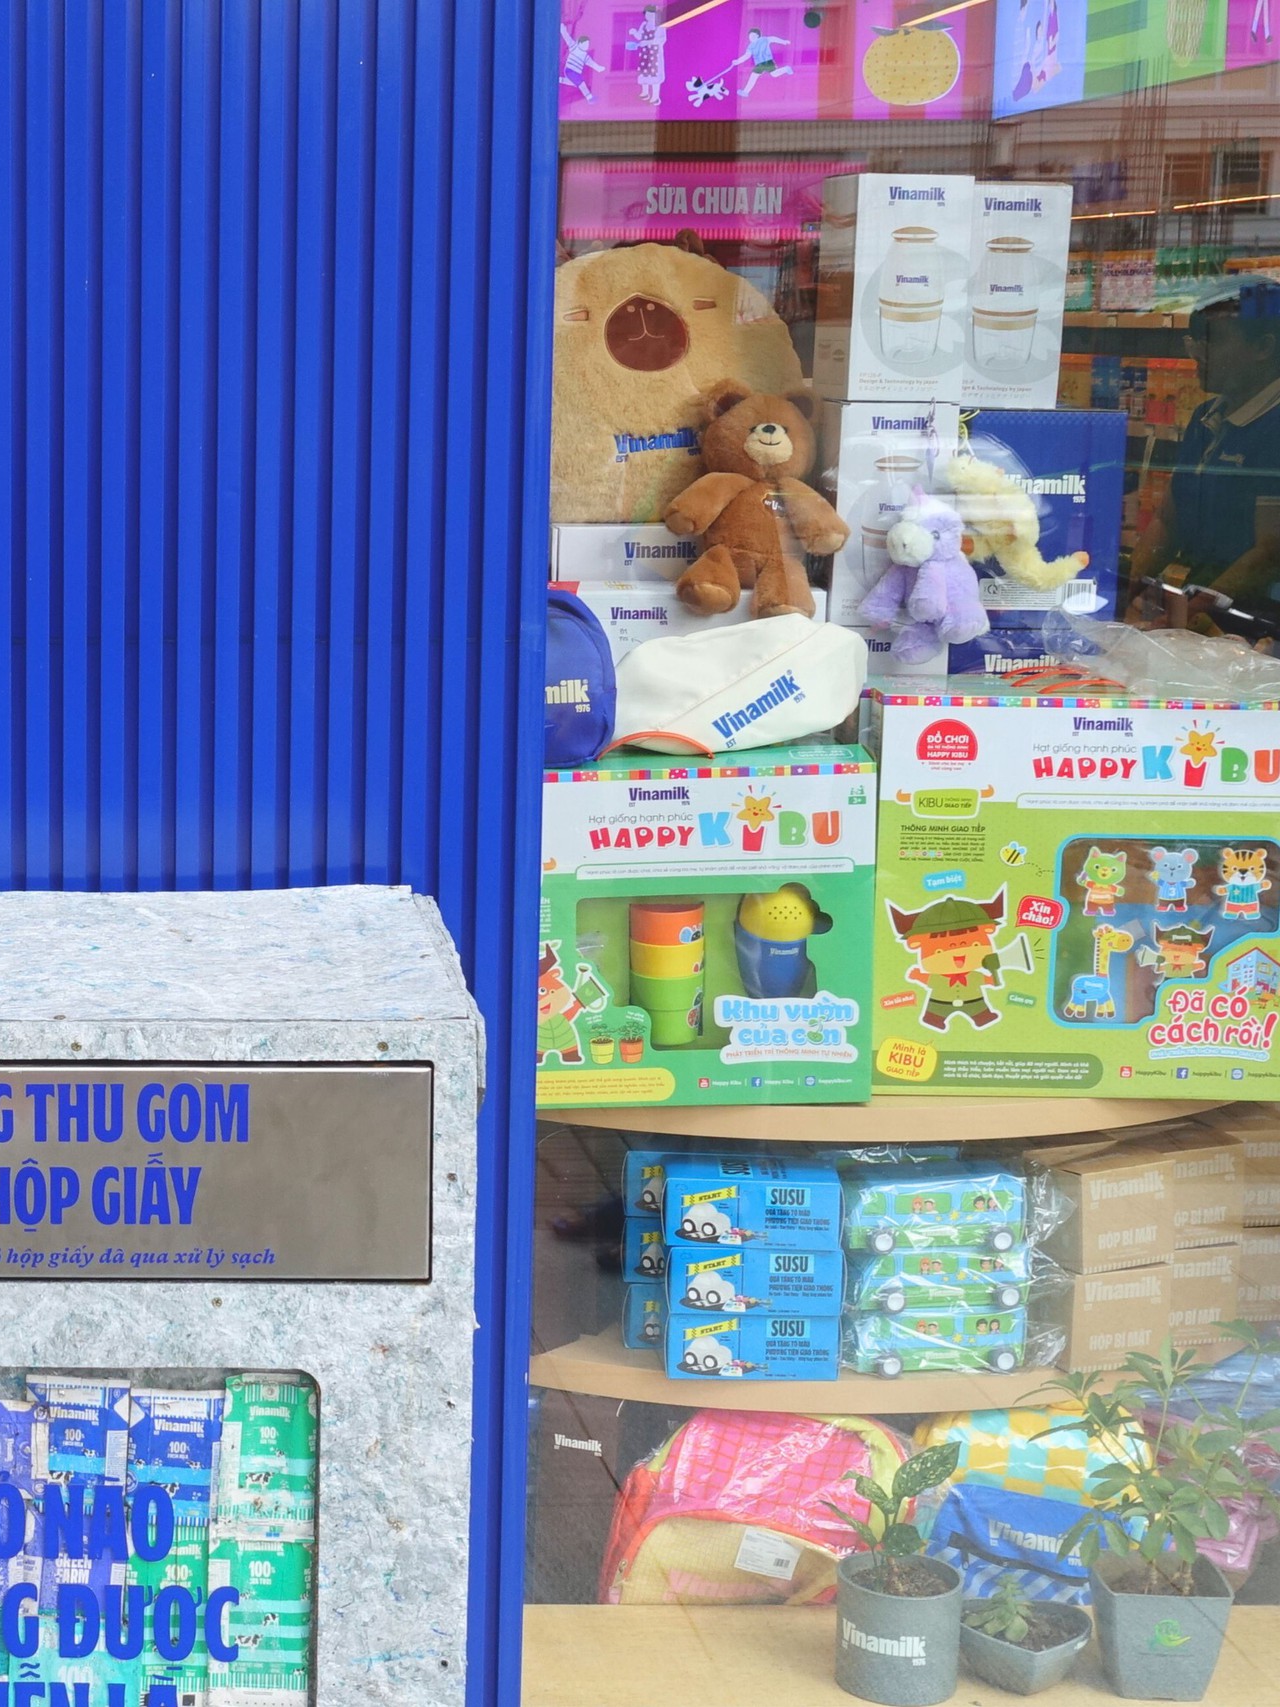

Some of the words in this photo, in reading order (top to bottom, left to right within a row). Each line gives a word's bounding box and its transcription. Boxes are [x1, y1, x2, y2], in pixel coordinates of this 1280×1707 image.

[646, 183, 688, 214] SỮA
[692, 187, 747, 214] CHUA
[754, 182, 783, 214] ĂN
[889, 186, 945, 201] Vinamilk
[984, 197, 1042, 212] Vinamilk
[895, 274, 929, 284] Vinamilk
[989, 284, 1024, 293] Vinamilk
[872, 416, 929, 431] Vinamilk
[614, 427, 701, 454] Vinamilk
[625, 542, 697, 558] Vinamilk
[611, 606, 668, 620] Vinamilk
[545, 678, 591, 704] milk
[793, 690, 806, 704] 1976
[575, 704, 591, 713] 1976
[711, 673, 801, 739] Vinamilk
[1073, 716, 1133, 731] Vinamilk
[726, 738, 737, 749] EST
[1033, 743, 1051, 754] Hạt
[1052, 742, 1080, 757] giống
[1082, 743, 1109, 757] hạnh
[1111, 743, 1137, 755] phúc
[1032, 755, 1138, 779] HAPPY
[628, 786, 690, 802] Vinamilk
[918, 797, 944, 808] KIBU
[588, 814, 605, 825] Hạt
[608, 813, 636, 827] giống
[639, 813, 665, 826] hạnh
[667, 811, 694, 826] phúc
[901, 823, 927, 832] THÔNG
[971, 822, 986, 832] TIẾP
[589, 825, 695, 850] HAPPY
[1030, 900, 1051, 915] Xin
[1022, 910, 1054, 925] chào!
[722, 999, 780, 1022] Khu
[784, 996, 854, 1022] vườn
[1166, 989, 1205, 1013] Đã
[1210, 986, 1249, 1018] có
[737, 1022, 789, 1046] của
[1149, 1014, 1220, 1045] cách
[1224, 1012, 1278, 1048] rồi!
[893, 1042, 915, 1055] Mình
[888, 1052, 925, 1069] KIBU
[886, 1066, 904, 1075] GIAO
[905, 1067, 920, 1078] TIẾP
[26, 1084, 124, 1143] THU
[138, 1083, 249, 1143] GOM
[1174, 1153, 1236, 1180] namilk
[92, 1152, 201, 1225] GIẤY
[1089, 1170, 1165, 1201] Vinamilk
[698, 1191, 722, 1202] START
[770, 1188, 805, 1206] SUSU
[7, 1248, 45, 1269] hộp
[48, 1245, 94, 1268] giấy
[99, 1247, 125, 1264] đã
[130, 1251, 169, 1268] qua
[174, 1247, 202, 1264] xử
[206, 1248, 226, 1268] lý
[231, 1248, 276, 1269] sạch
[702, 1259, 726, 1270] START
[774, 1255, 809, 1272] SUSU
[1173, 1255, 1232, 1279] namilk
[1084, 1275, 1161, 1303] Vinamilk
[699, 1324, 724, 1335] START
[771, 1320, 805, 1337] SUSU
[49, 1406, 100, 1422] Vinamilk
[249, 1405, 291, 1419] Vinamilk
[154, 1418, 205, 1434] Vinamilk
[554, 1433, 602, 1453] Vinamilk
[44, 1477, 174, 1562] NÀO
[56, 1585, 241, 1671] ĐƯỢC
[842, 1617, 926, 1658] Vinamilk
